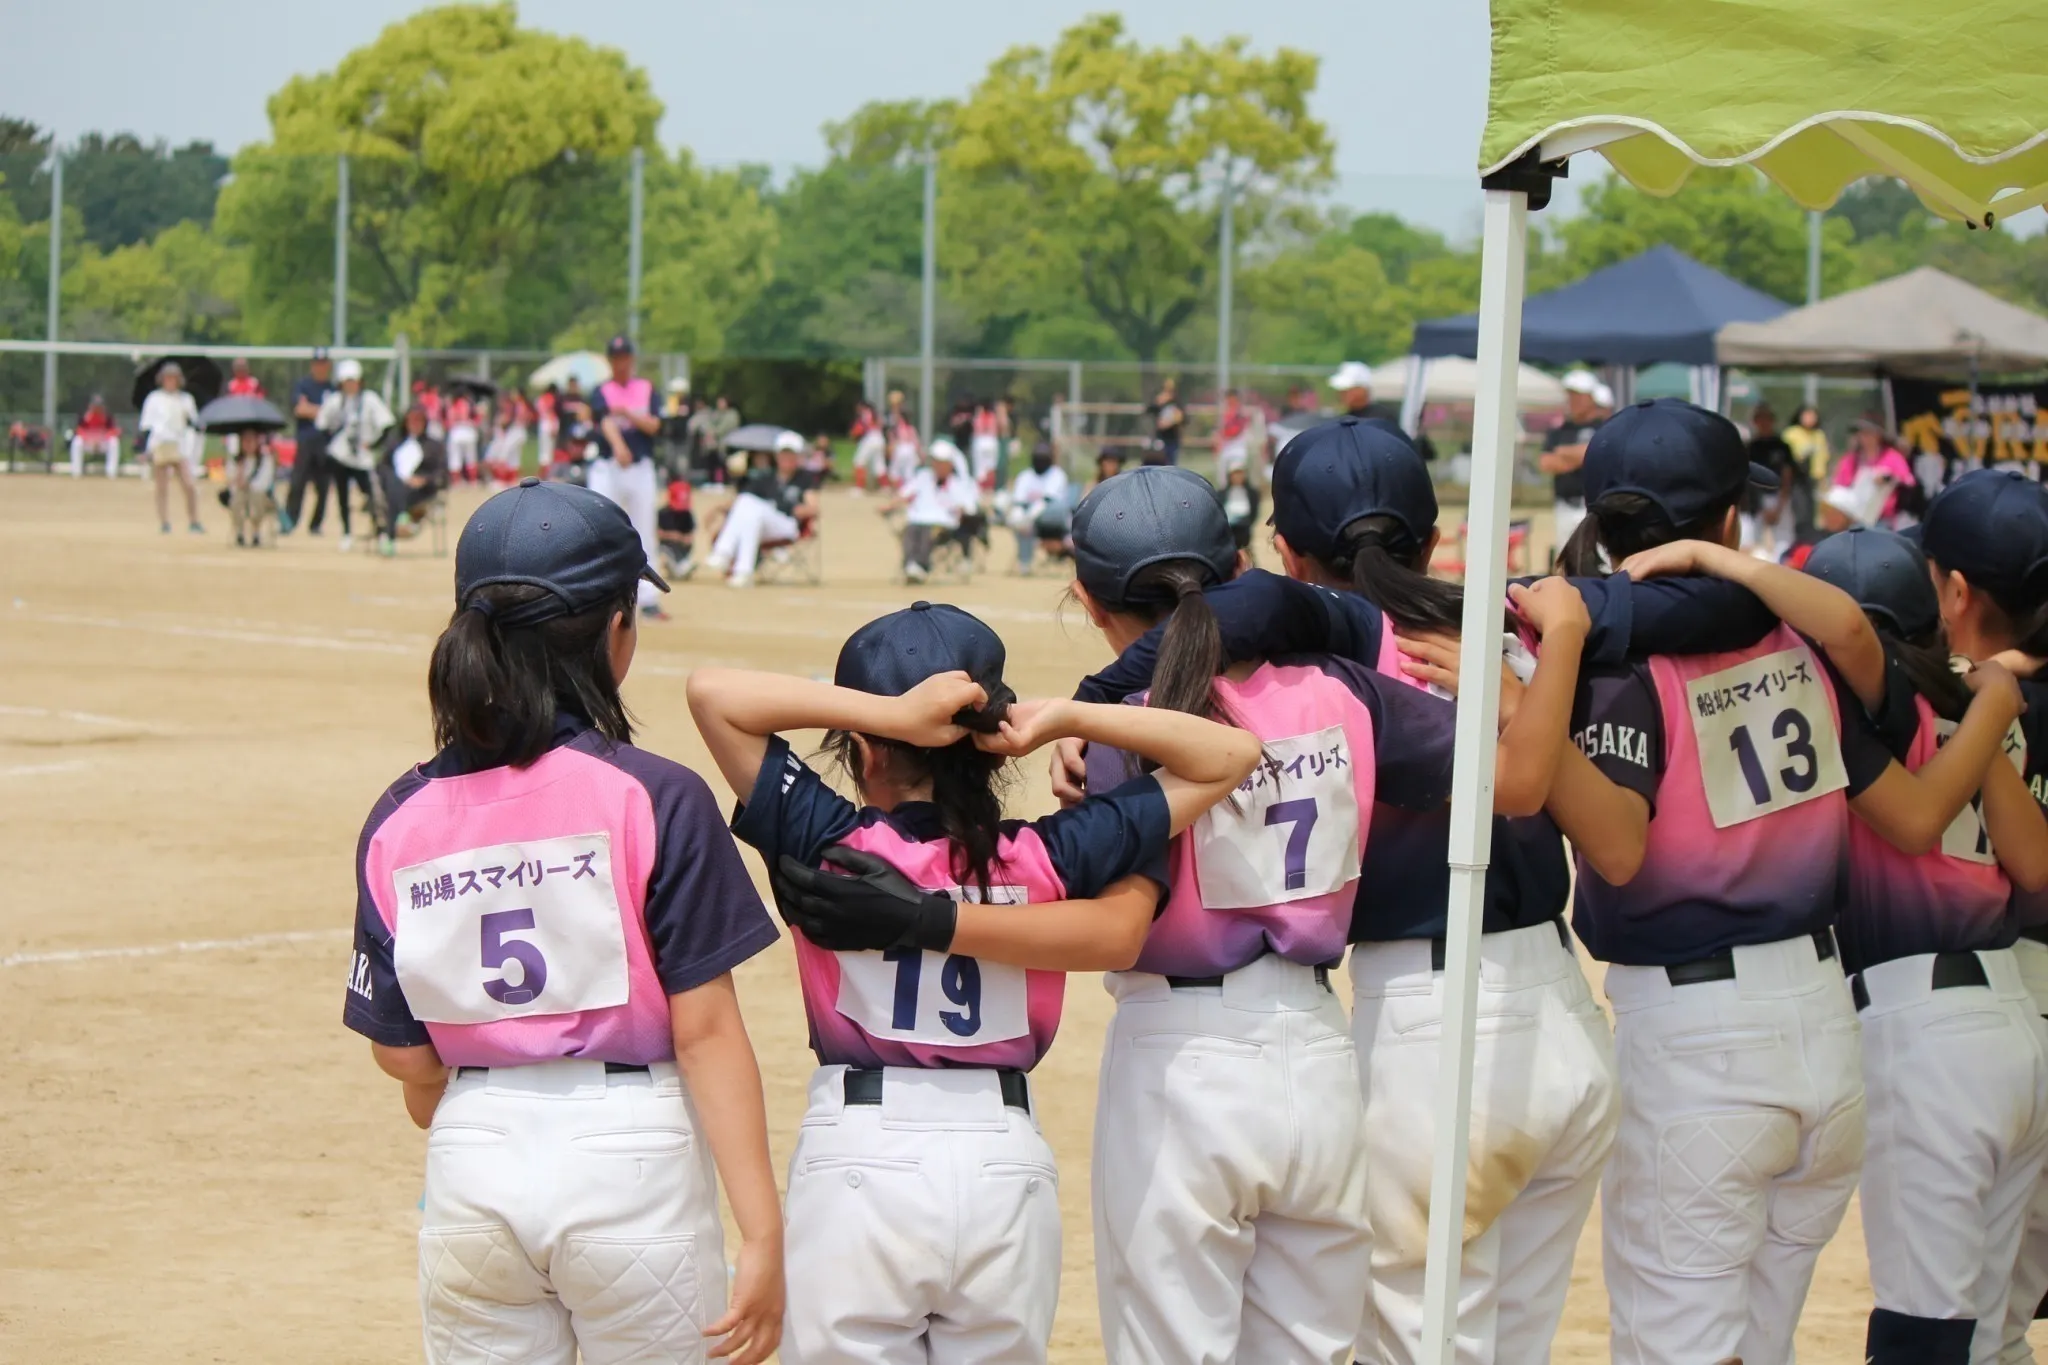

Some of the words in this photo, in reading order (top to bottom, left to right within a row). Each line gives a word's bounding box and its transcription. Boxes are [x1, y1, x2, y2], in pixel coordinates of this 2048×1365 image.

[1574, 722, 1649, 768] OSAKA
[1729, 707, 1818, 806] 13
[410, 850, 597, 910] 船場スマイリーズ
[1264, 797, 1319, 891] 7
[480, 907, 548, 1006] 5
[883, 949, 982, 1037] 19
